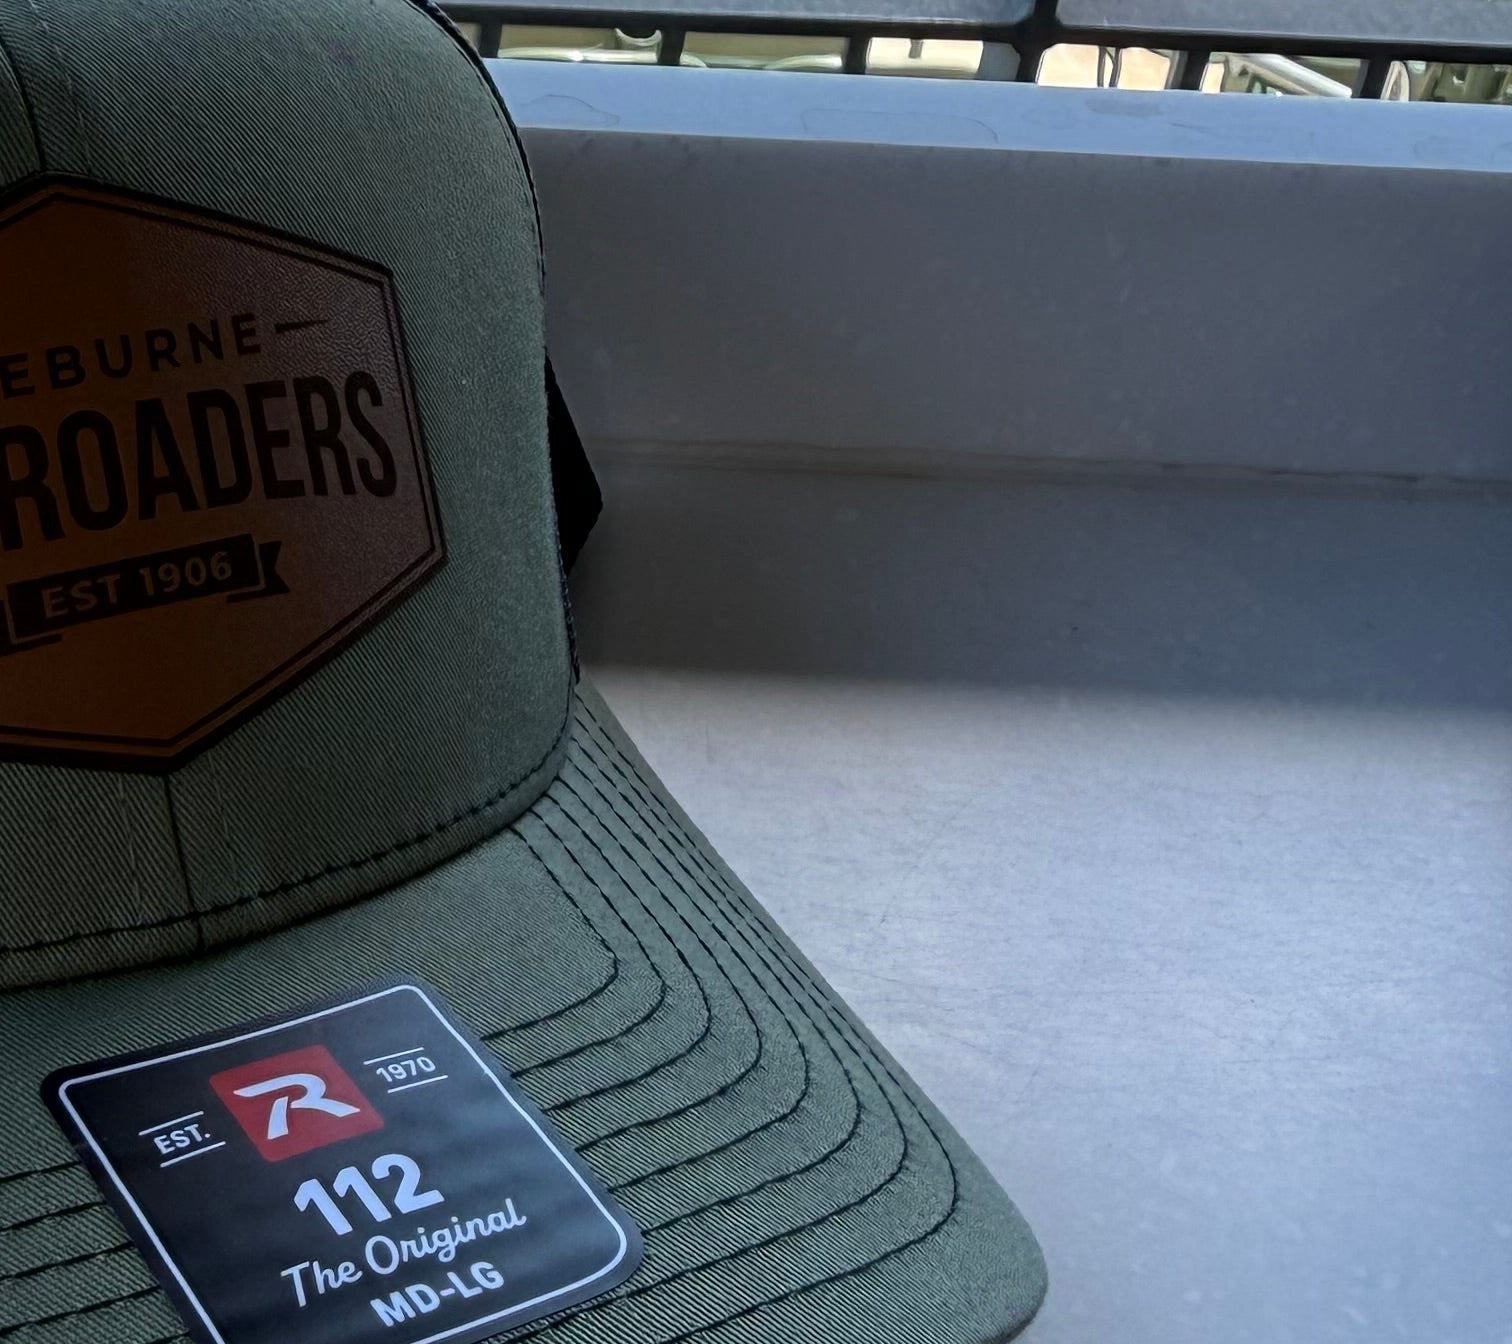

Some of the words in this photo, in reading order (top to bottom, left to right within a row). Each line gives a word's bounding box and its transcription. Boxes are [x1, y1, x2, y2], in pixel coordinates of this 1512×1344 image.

[41, 574, 122, 621] EST
[140, 550, 235, 596] 1906
[153, 1125, 212, 1156] EST.
[375, 1055, 437, 1084] 1970
[293, 1153, 445, 1236] 112
[280, 1256, 364, 1308] The
[364, 1197, 528, 1275] Original
[370, 1260, 505, 1328] MD-LG
